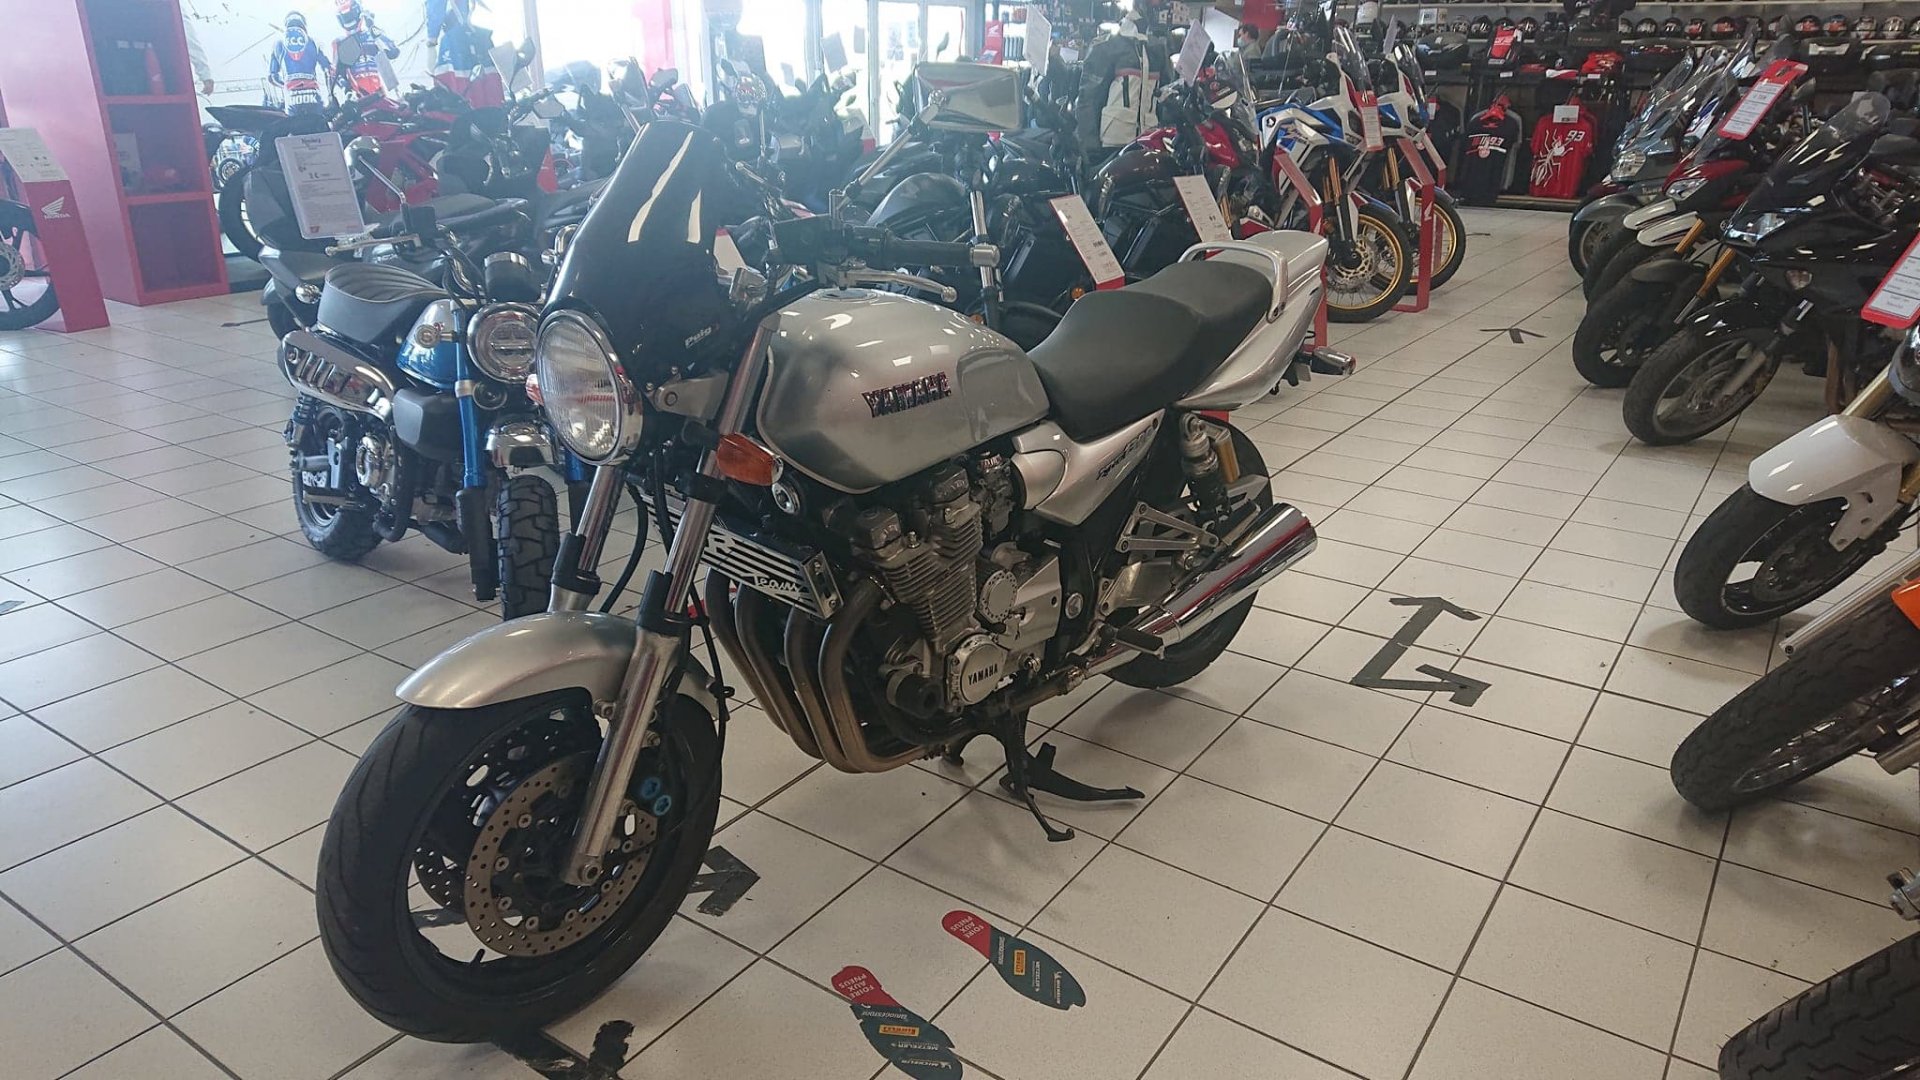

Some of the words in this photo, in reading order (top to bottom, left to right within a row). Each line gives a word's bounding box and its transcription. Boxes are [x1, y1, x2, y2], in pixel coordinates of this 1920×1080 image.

[1565, 130, 1586, 142] 93
[684, 326, 712, 349] Puig
[861, 371, 952, 418] YAMAHA
[968, 663, 998, 686] YAMAHA
[950, 915, 973, 933] PNEUS
[959, 921, 977, 935] AUX
[964, 923, 985, 939] FOIRE
[838, 974, 867, 990] PNEUS
[847, 980, 867, 993] AUX
[849, 985, 874, 999] FOIRE
